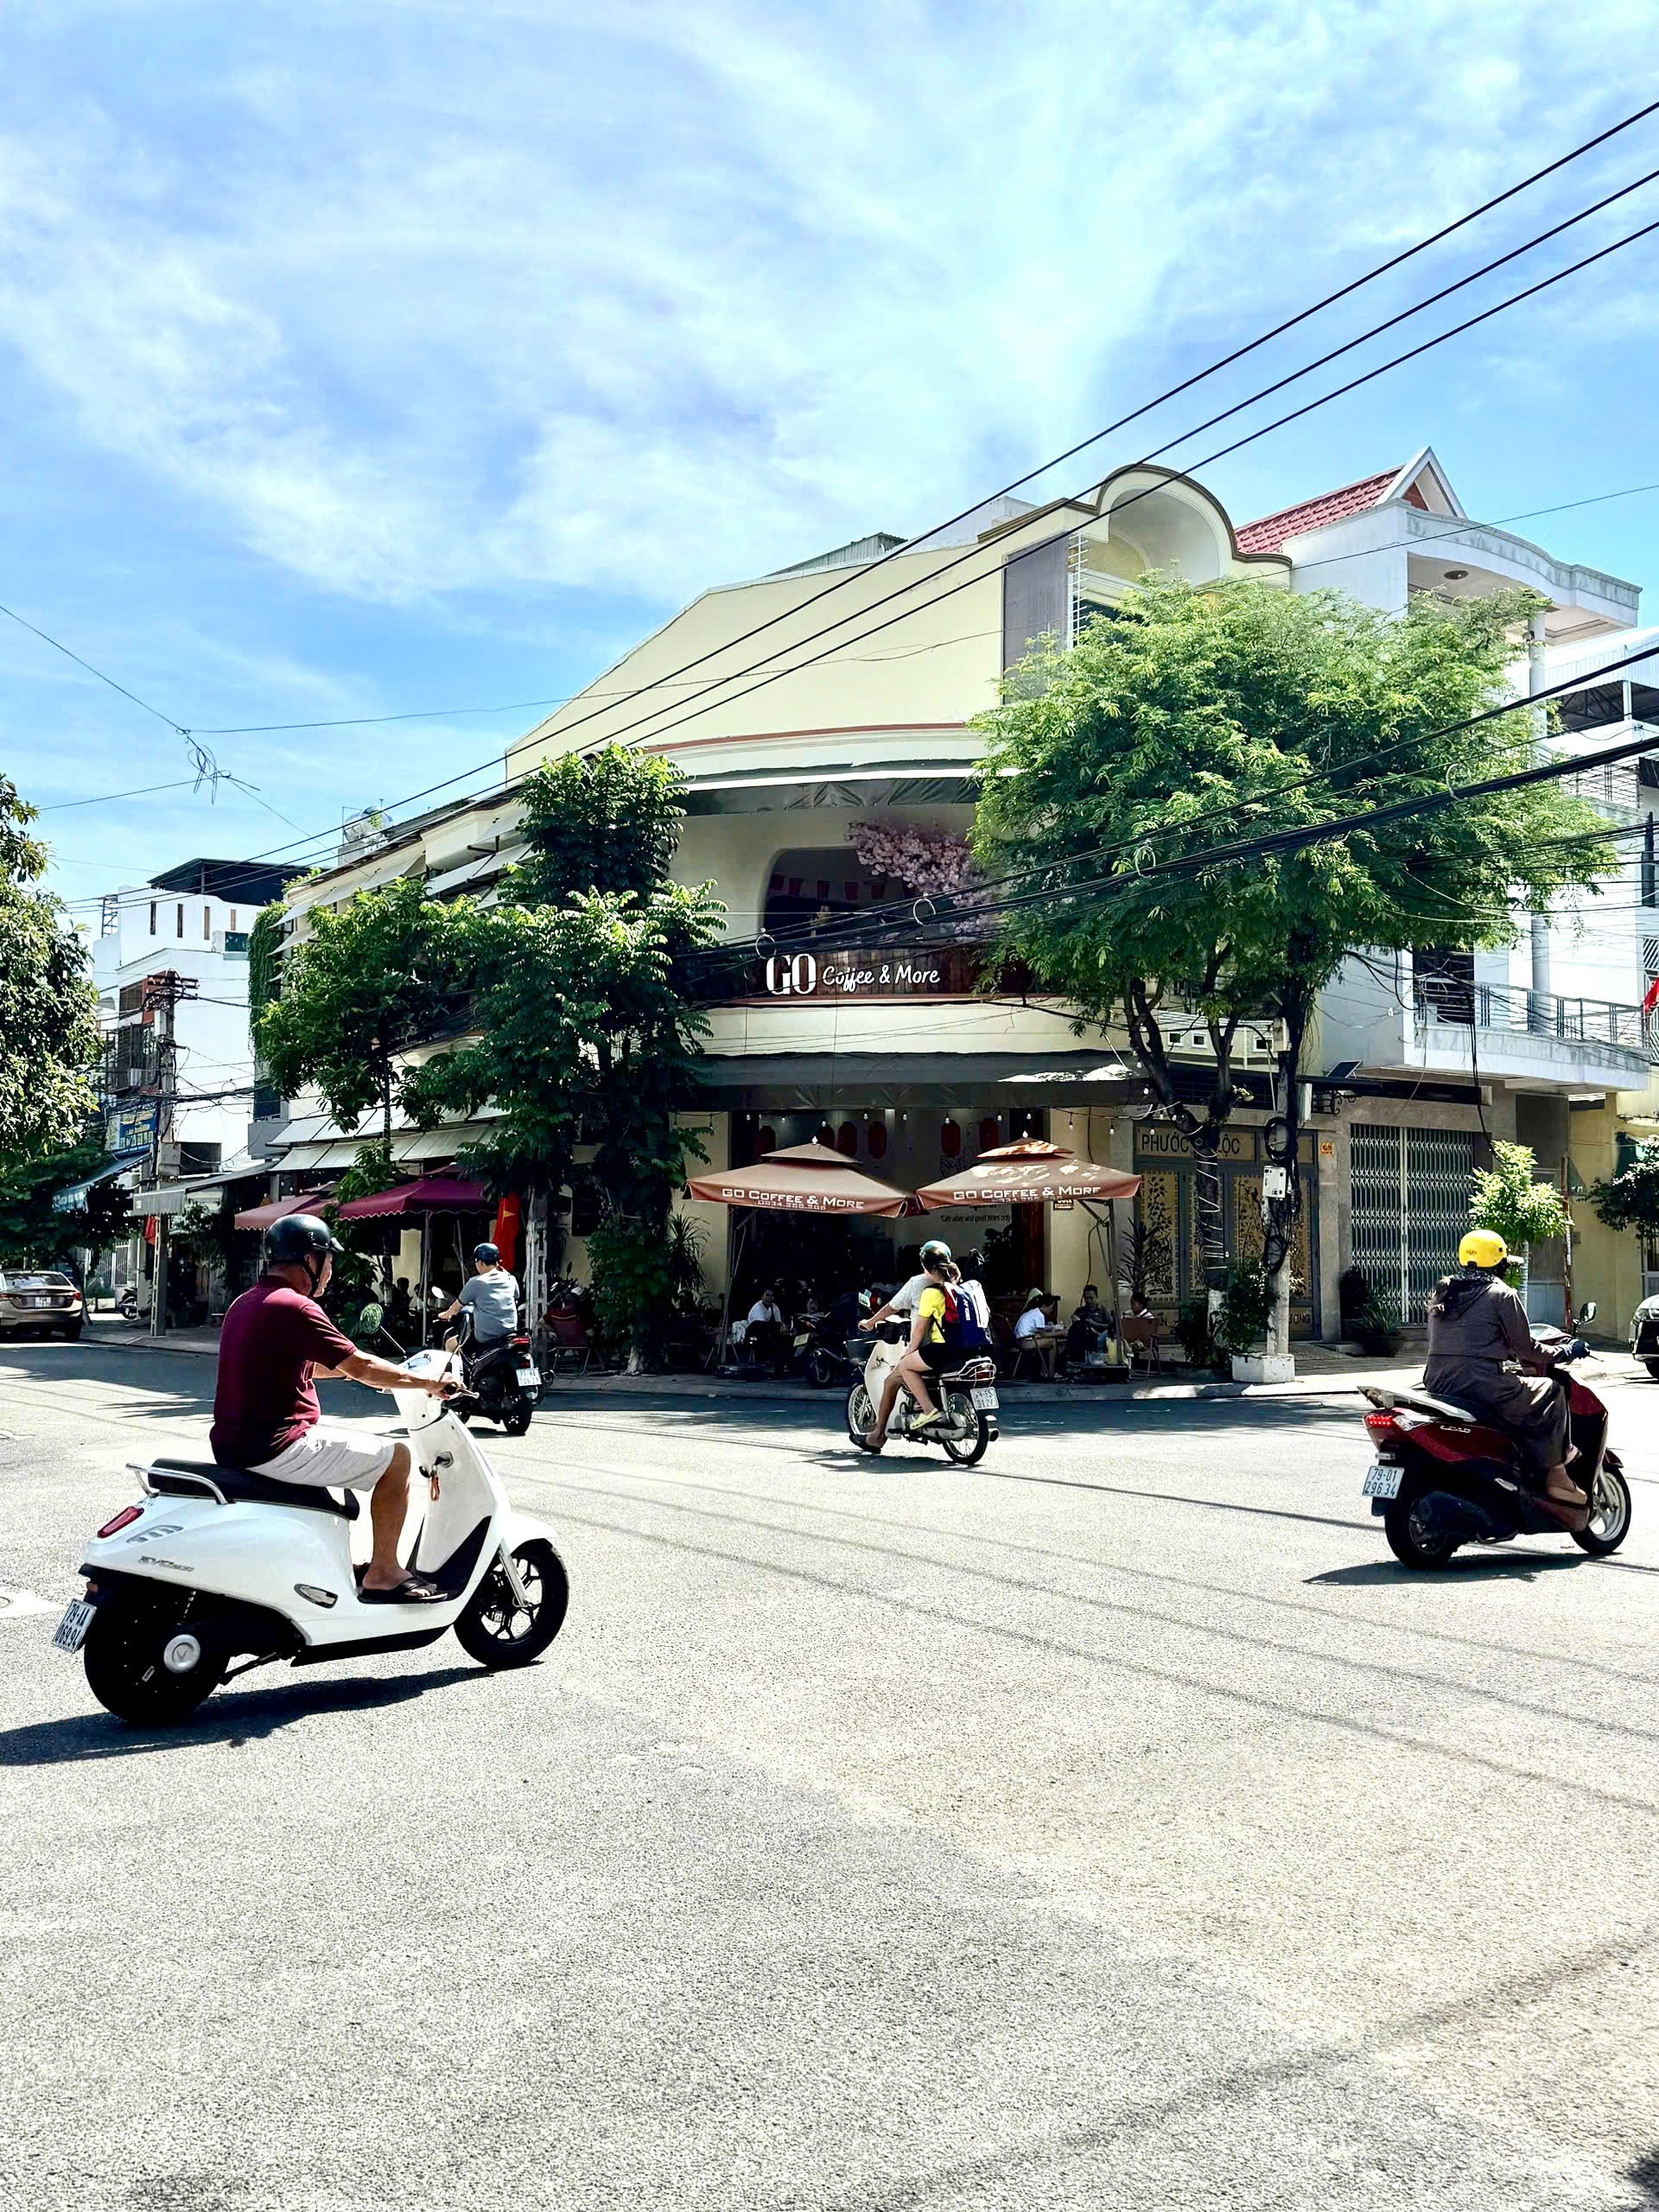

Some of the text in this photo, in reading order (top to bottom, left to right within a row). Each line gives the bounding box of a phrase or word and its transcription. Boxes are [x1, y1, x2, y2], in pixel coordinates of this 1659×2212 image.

[766, 954, 941, 995] GO Coffee & More
[1217, 1134, 1240, 1156] ỘC
[721, 1188, 865, 1209] GO COFFEE & MORE
[953, 1191, 976, 1200] GO
[981, 1188, 1038, 1199] COFFEE
[1042, 1186, 1054, 1196] &
